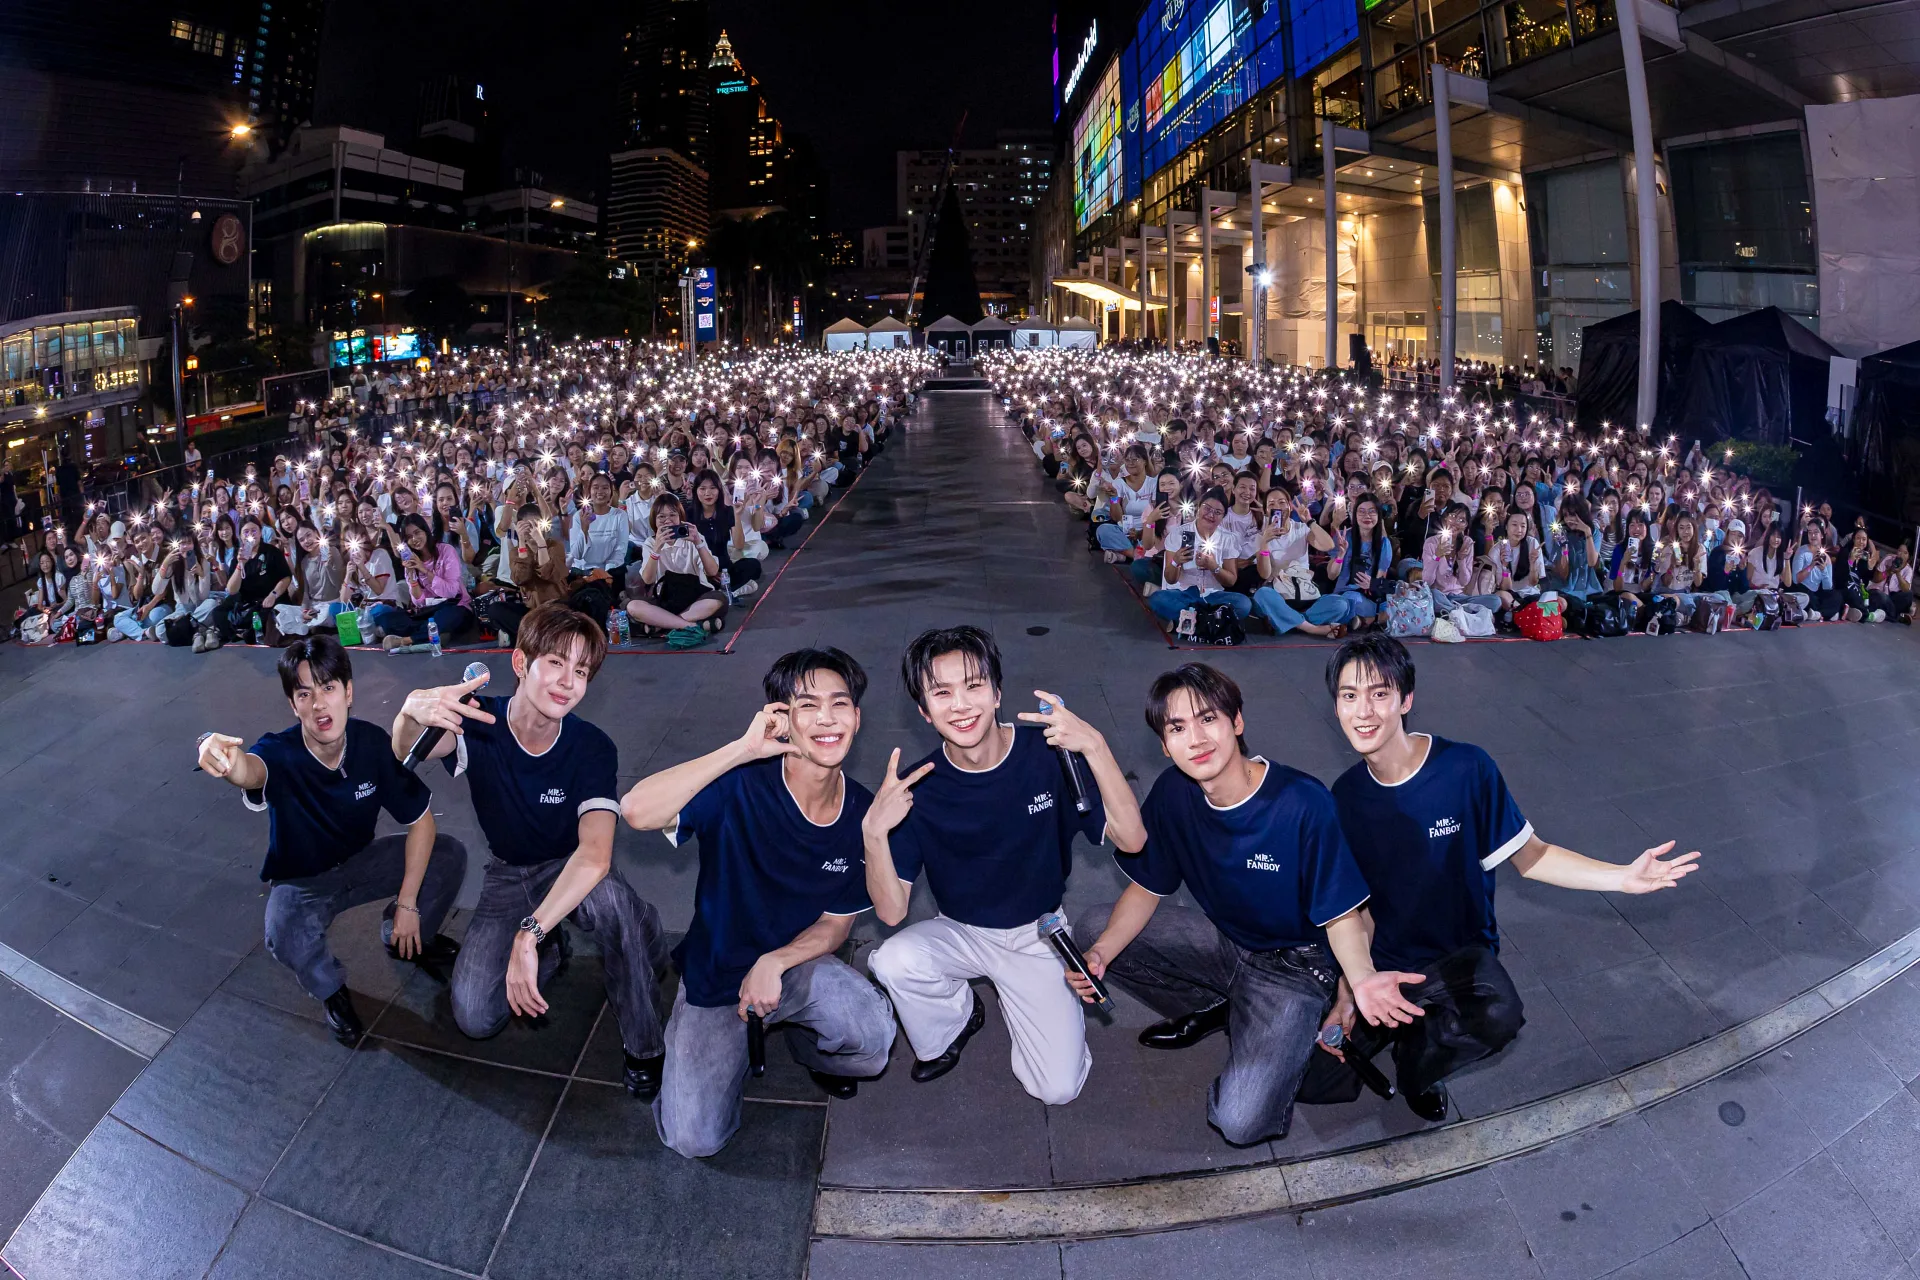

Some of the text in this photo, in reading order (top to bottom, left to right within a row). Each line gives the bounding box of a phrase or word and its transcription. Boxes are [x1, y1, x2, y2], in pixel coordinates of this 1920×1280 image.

[716, 85, 749, 95] PRESTIGE
[1033, 793, 1049, 804] MR.
[1435, 818, 1452, 828] MR.
[1428, 822, 1462, 839] FANBOY
[1254, 853, 1270, 863] MR.
[1246, 858, 1281, 873] FANBOY
